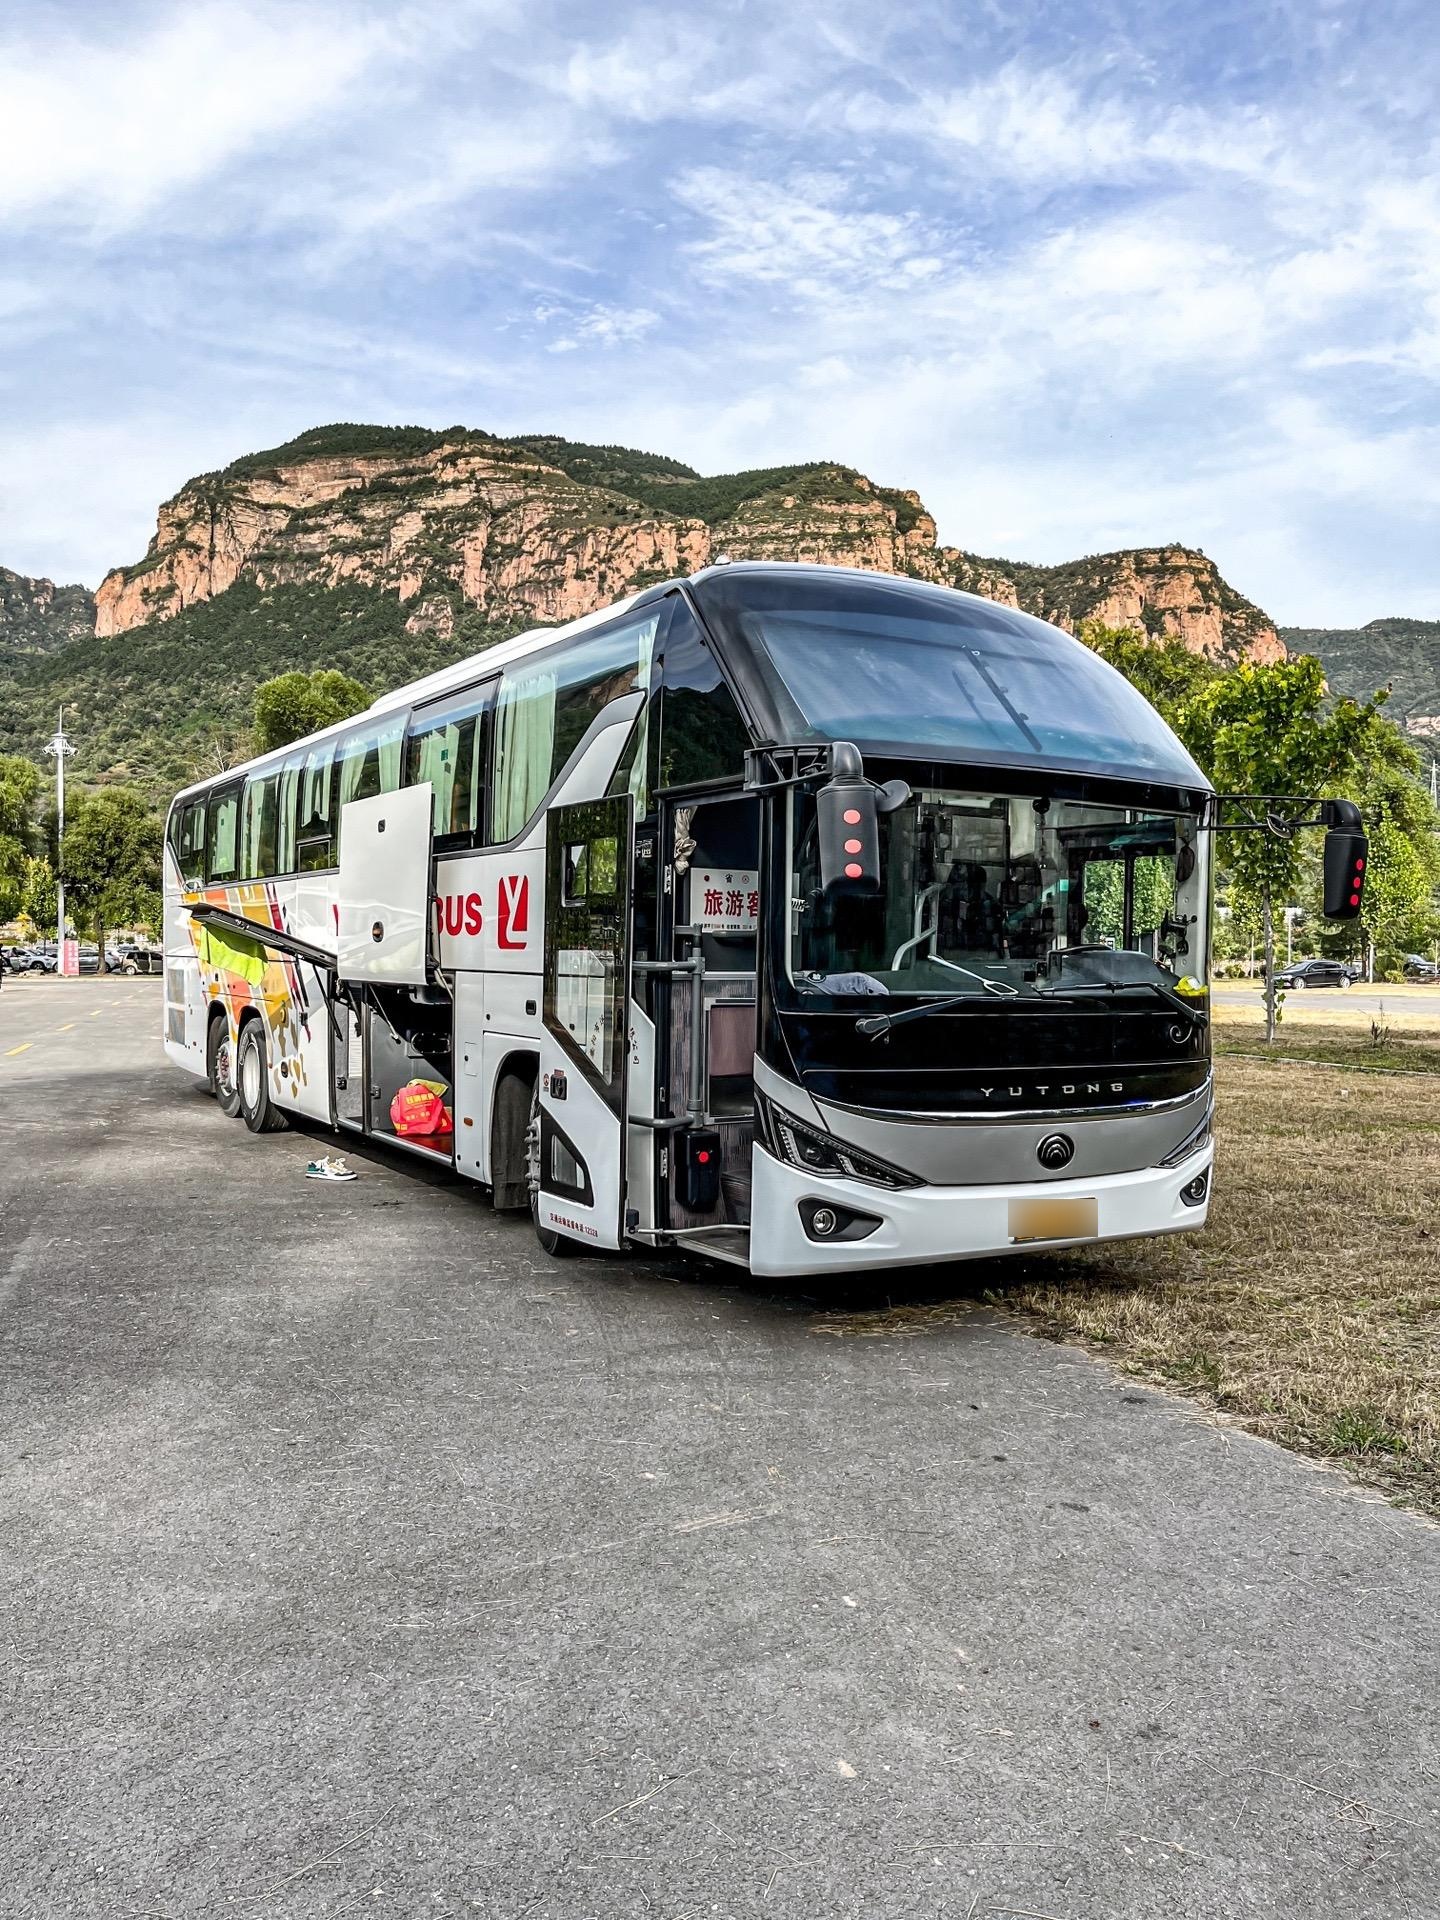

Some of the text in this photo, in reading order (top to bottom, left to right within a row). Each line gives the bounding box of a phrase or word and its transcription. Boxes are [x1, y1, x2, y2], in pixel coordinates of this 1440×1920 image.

[704, 888, 759, 918] 旅游客
[980, 1083, 1123, 1097] YUTONG
